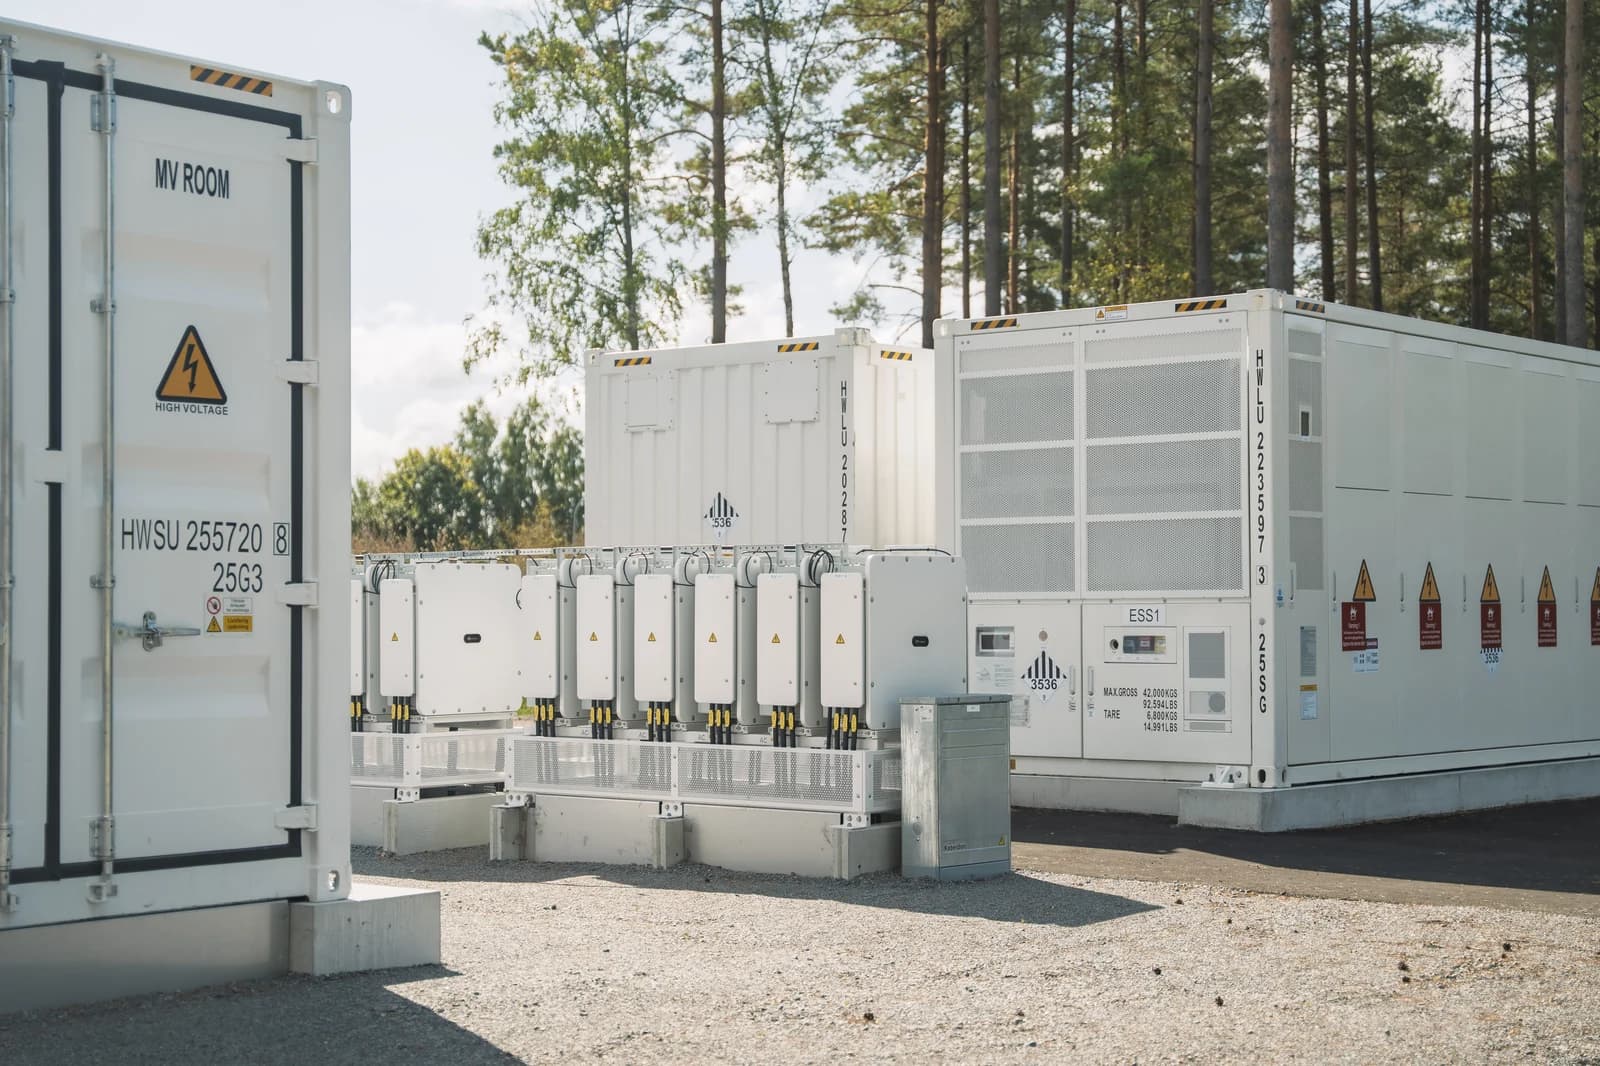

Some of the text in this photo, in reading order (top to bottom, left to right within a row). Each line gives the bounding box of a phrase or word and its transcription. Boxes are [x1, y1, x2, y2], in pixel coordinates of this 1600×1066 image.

[155, 158, 229, 199] MV ROOM
[155, 402, 229, 416] HIGH VOLTAGE
[840, 380, 848, 447] HWLU
[1256, 349, 1266, 584] HWLU 223597 3
[121, 518, 288, 554] HWSU 255720 8
[212, 562, 263, 593] 25G3
[1129, 608, 1160, 622] ESS1
[1031, 678, 1058, 690] 3536
[1258, 633, 1267, 714] 25SG
[1103, 709, 1121, 719] TARE
